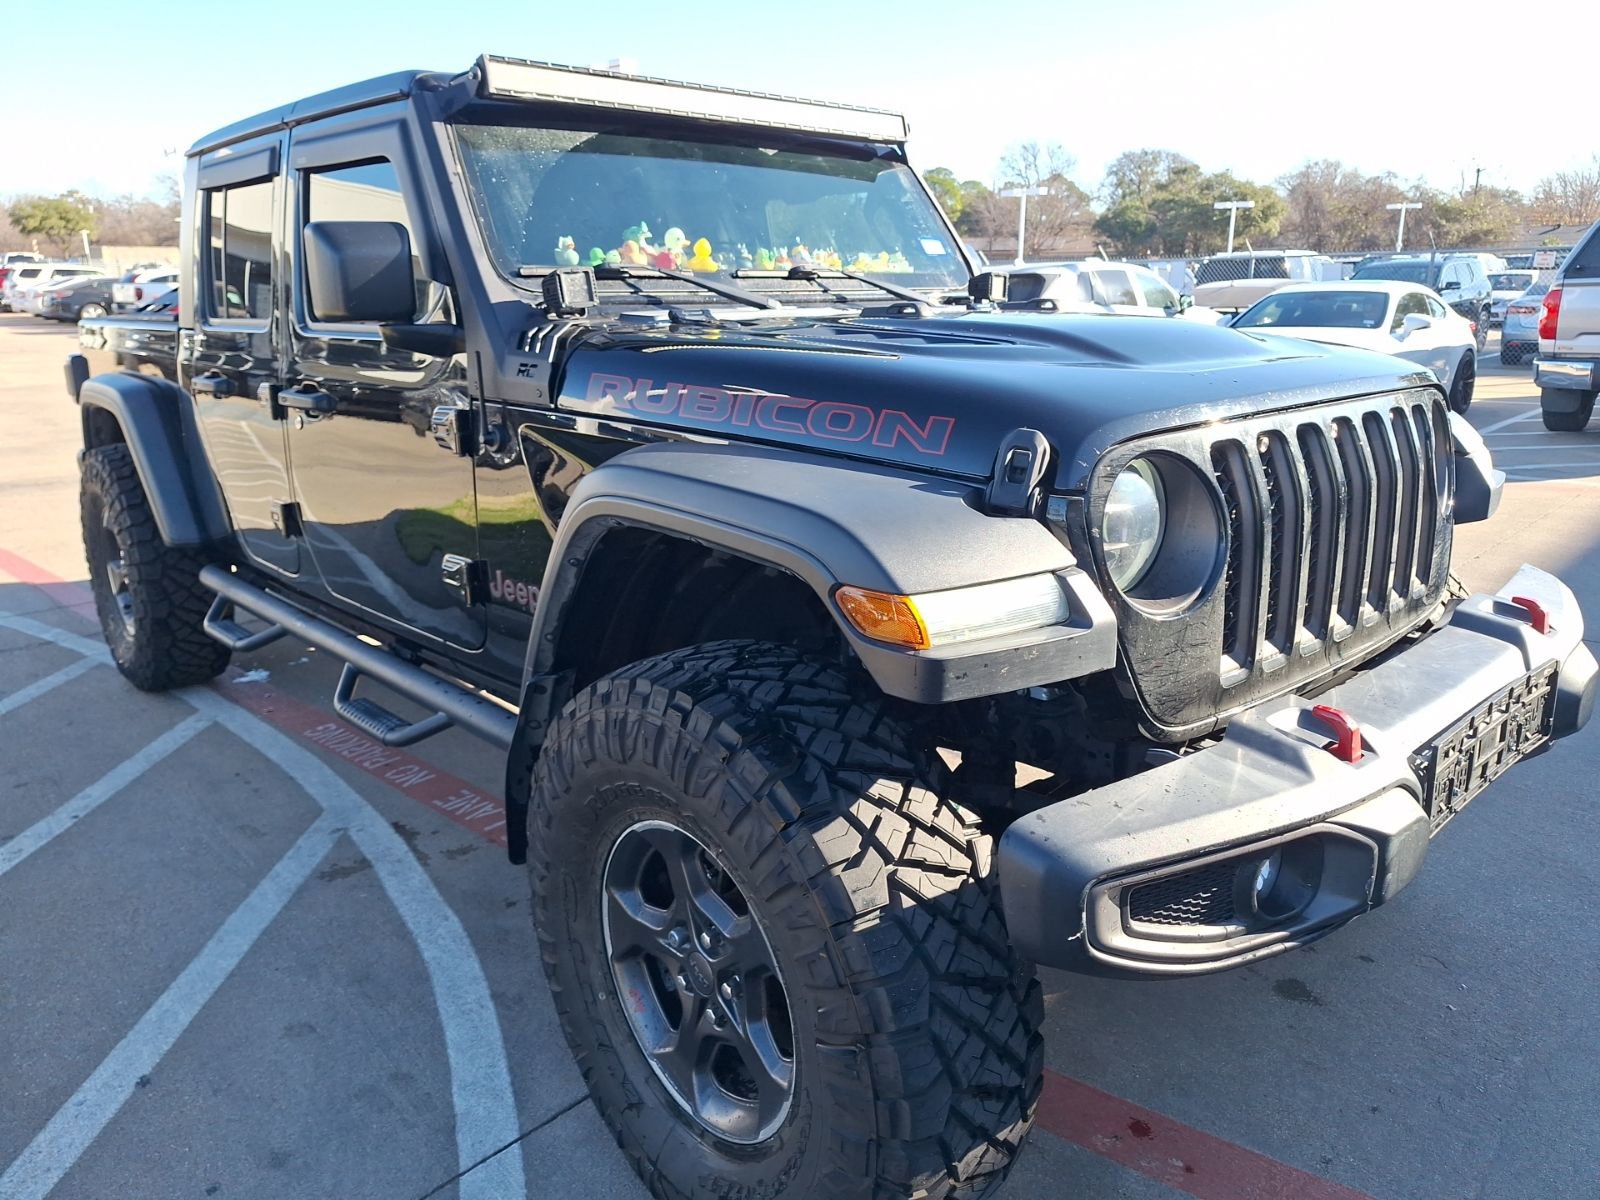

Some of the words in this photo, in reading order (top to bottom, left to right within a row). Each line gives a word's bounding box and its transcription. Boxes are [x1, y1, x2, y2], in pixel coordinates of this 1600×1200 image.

[585, 373, 955, 455] RUBICON
[489, 569, 540, 614] Jeep
[304, 723, 398, 769] PARKING
